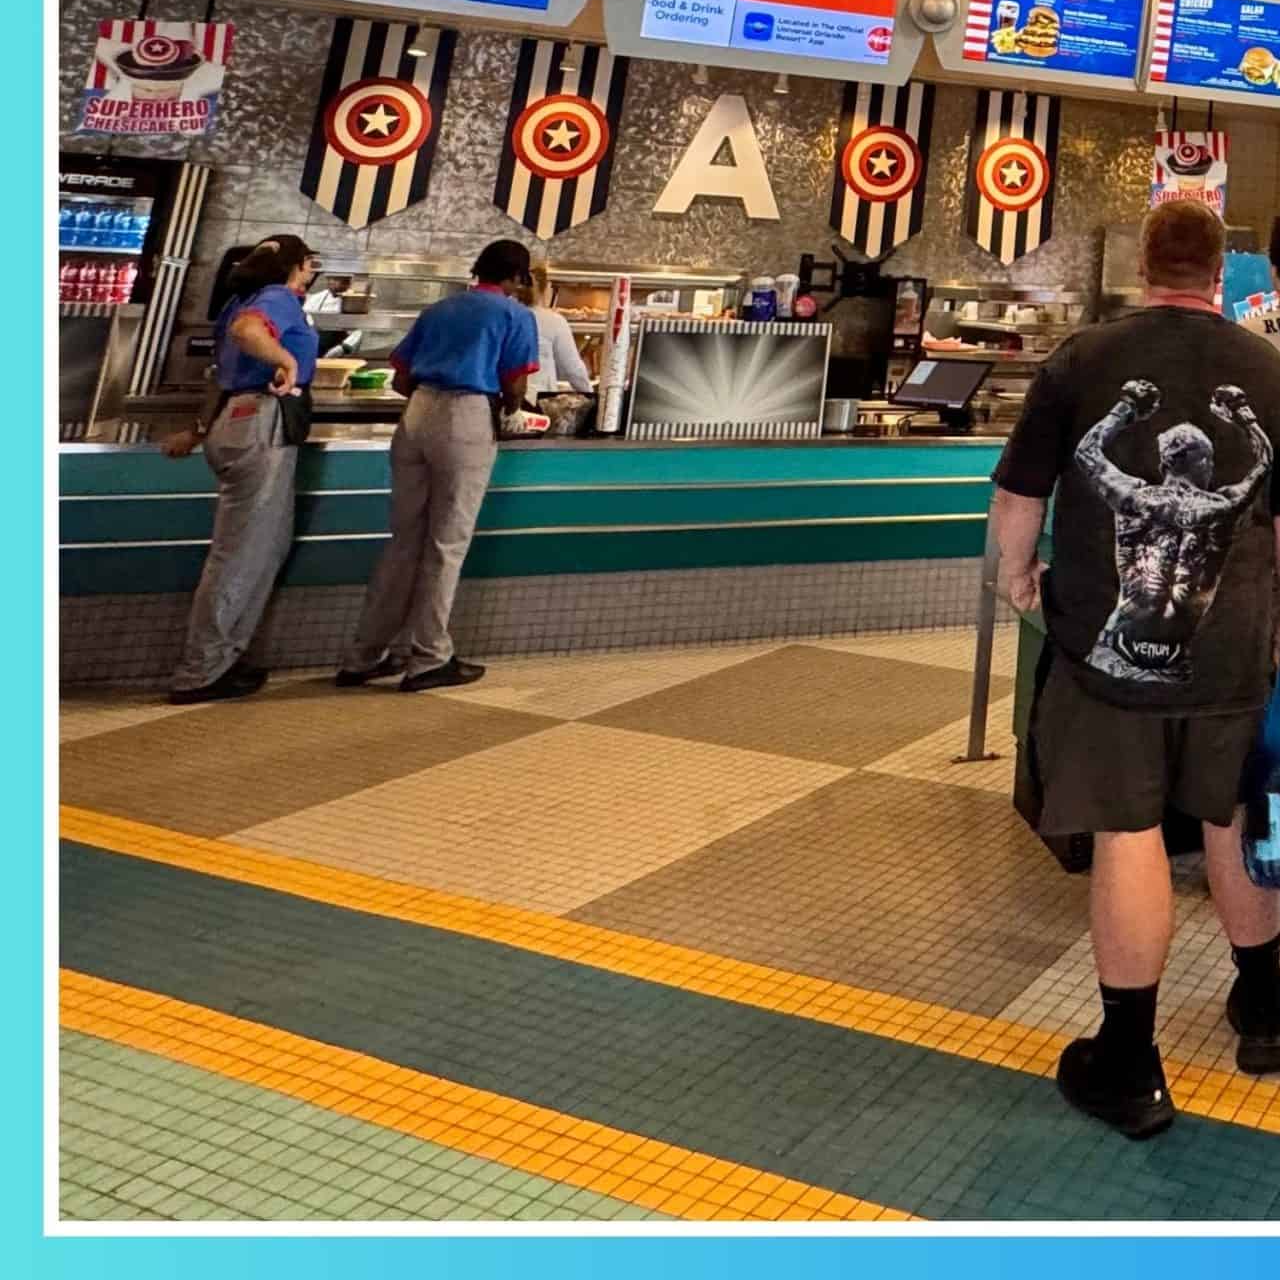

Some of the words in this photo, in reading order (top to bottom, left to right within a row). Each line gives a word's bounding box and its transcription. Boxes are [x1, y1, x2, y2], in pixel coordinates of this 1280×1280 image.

[679, 1, 688, 11] &
[691, 2, 724, 15] Drink
[655, 10, 709, 27] Ordering
[85, 97, 209, 118] SUPERHERO
[83, 115, 178, 133] CHEESECAKE
[179, 118, 212, 132] CUP
[653, 95, 781, 221] A
[1132, 640, 1170, 658] VENUM
